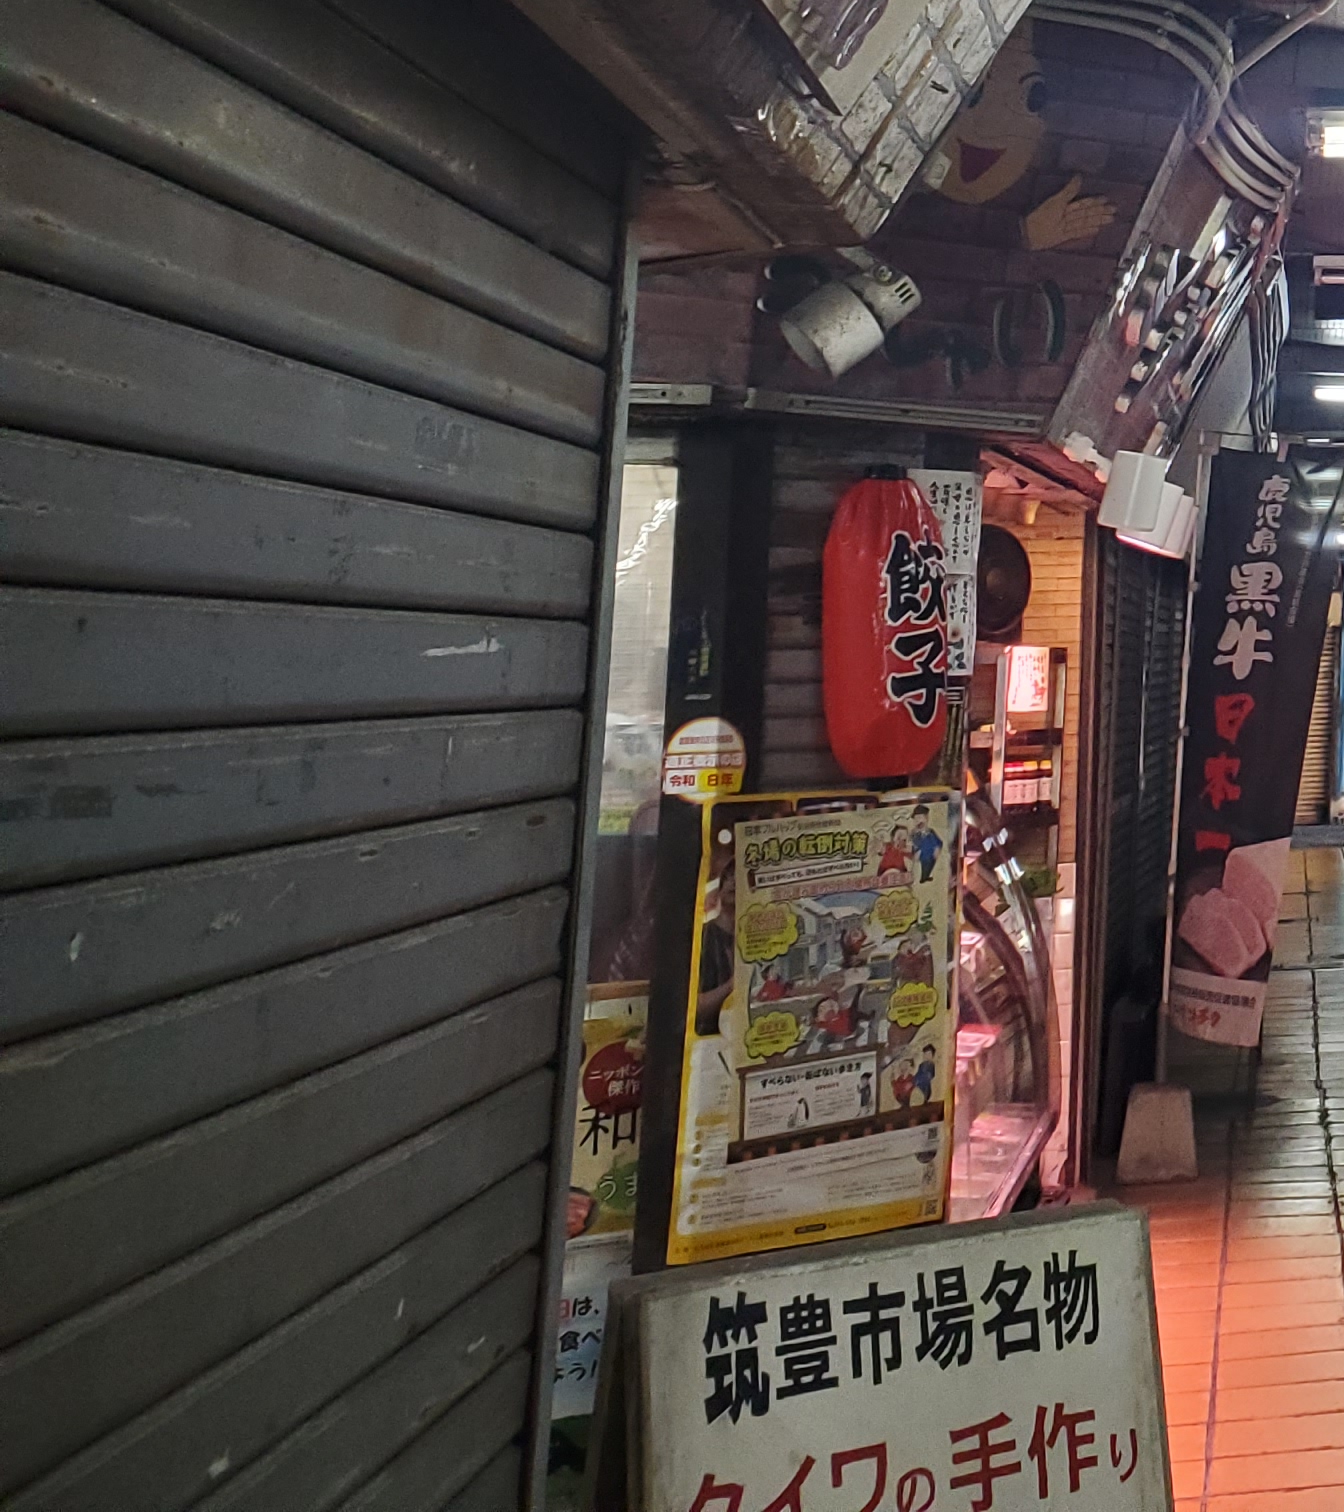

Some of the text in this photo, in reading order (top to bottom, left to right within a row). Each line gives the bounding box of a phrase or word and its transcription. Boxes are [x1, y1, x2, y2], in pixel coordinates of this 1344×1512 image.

[885, 531, 948, 728] 餃子
[703, 1251, 1100, 1424] 筑豊市場名物
